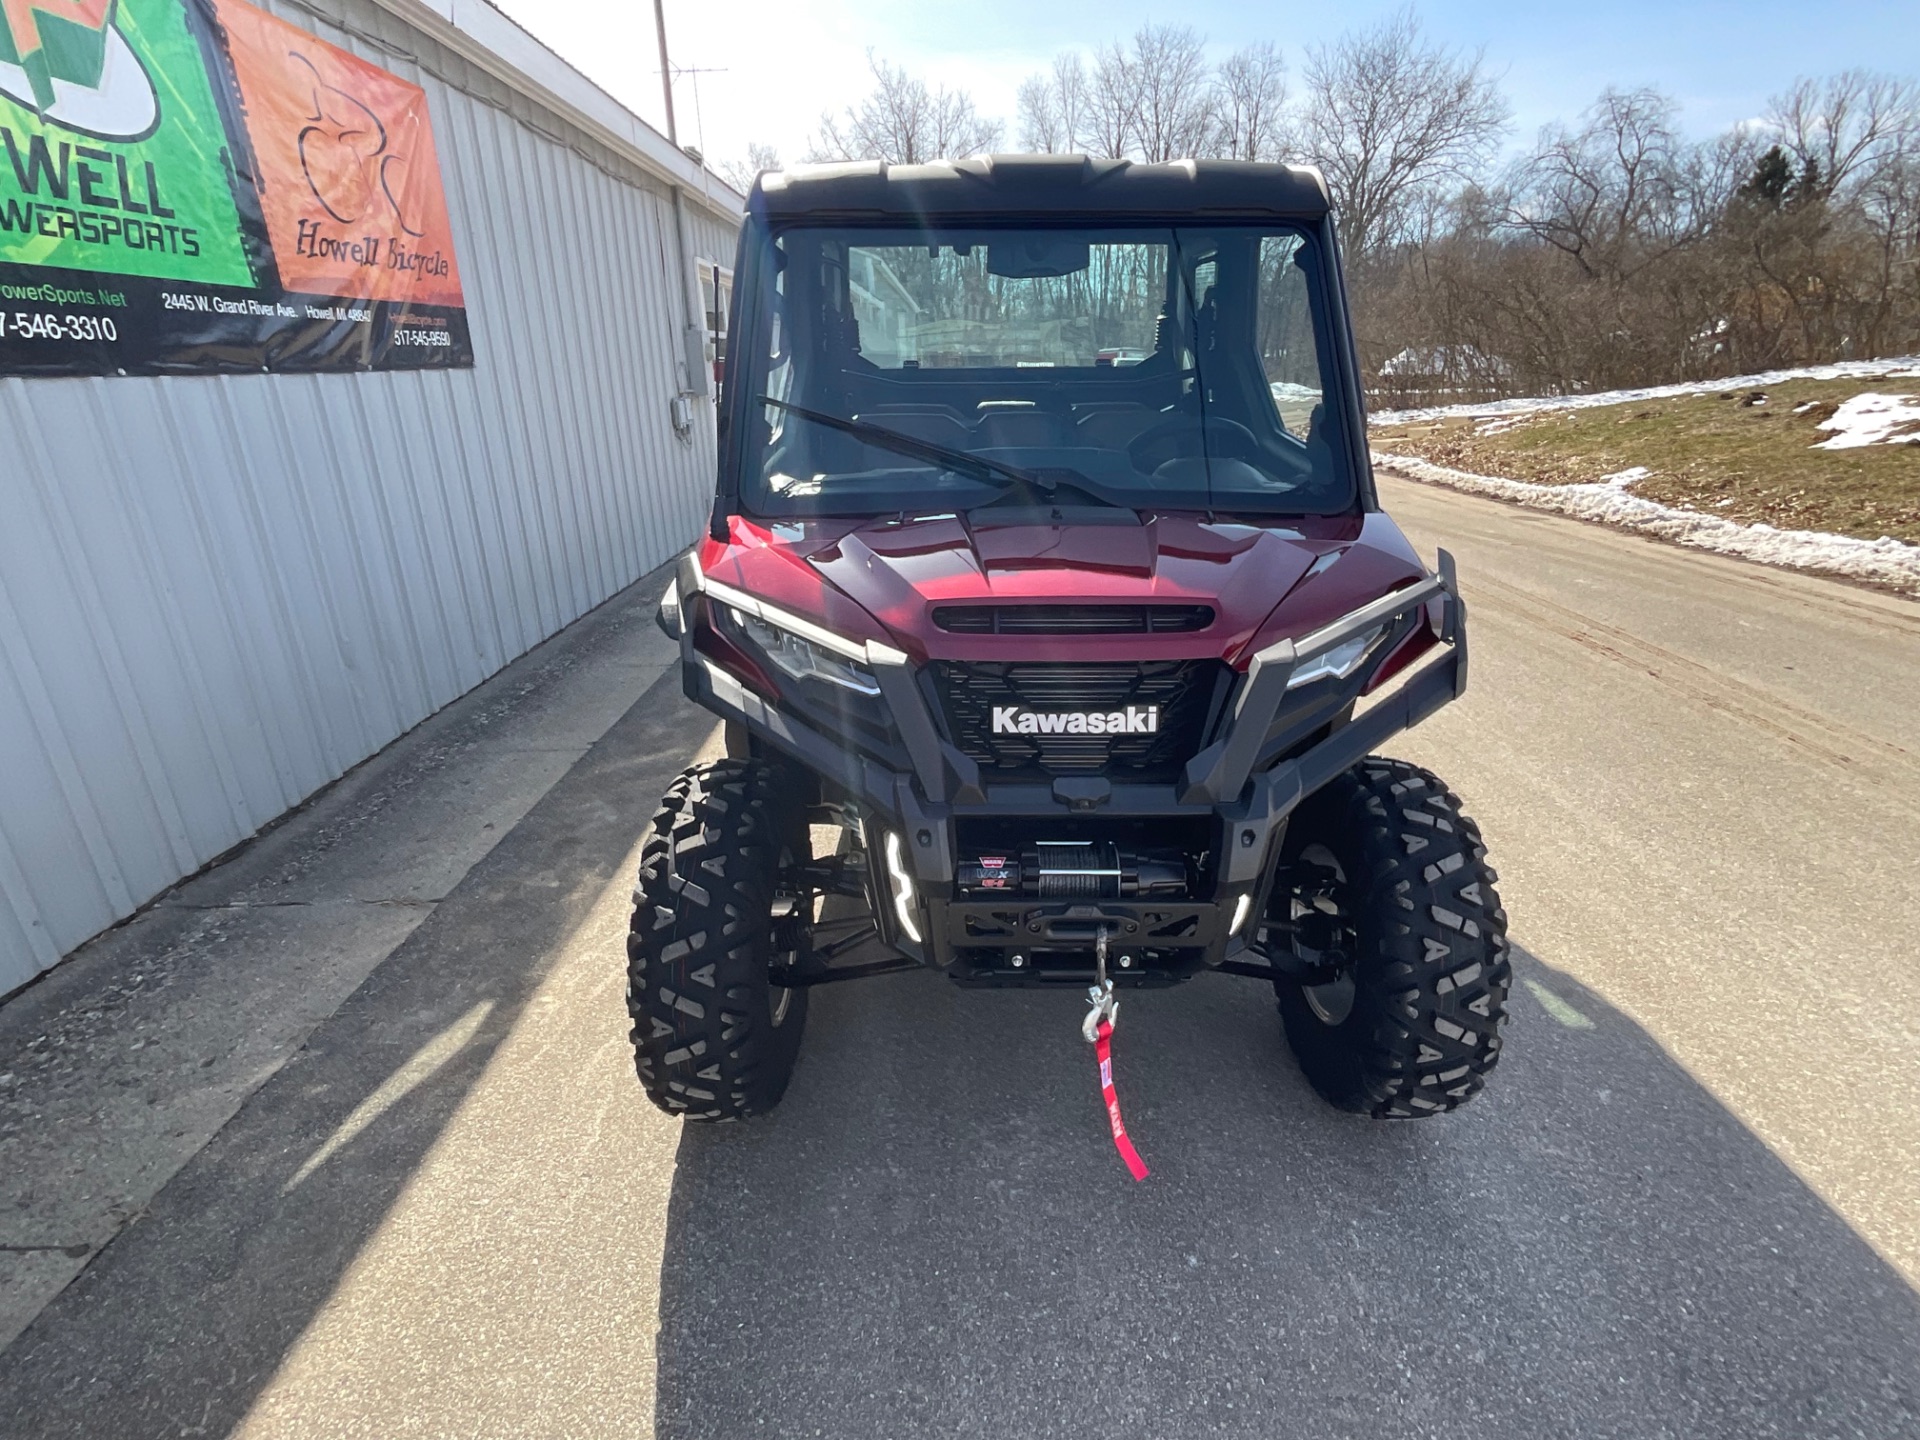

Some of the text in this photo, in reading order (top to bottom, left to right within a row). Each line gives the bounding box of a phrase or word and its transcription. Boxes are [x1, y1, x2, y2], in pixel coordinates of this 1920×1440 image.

[296, 219, 448, 281] Howell Bicycle
[0, 284, 128, 307] owerSports.Net
[162, 293, 195, 311] 2445
[194, 295, 212, 312] W.
[213, 297, 248, 315] Grand
[248, 300, 275, 316] River
[276, 303, 298, 318] Ave.
[336, 307, 348, 321] MI
[394, 329, 451, 347] 517-545-9590
[992, 705, 1157, 734] Kawasaki
